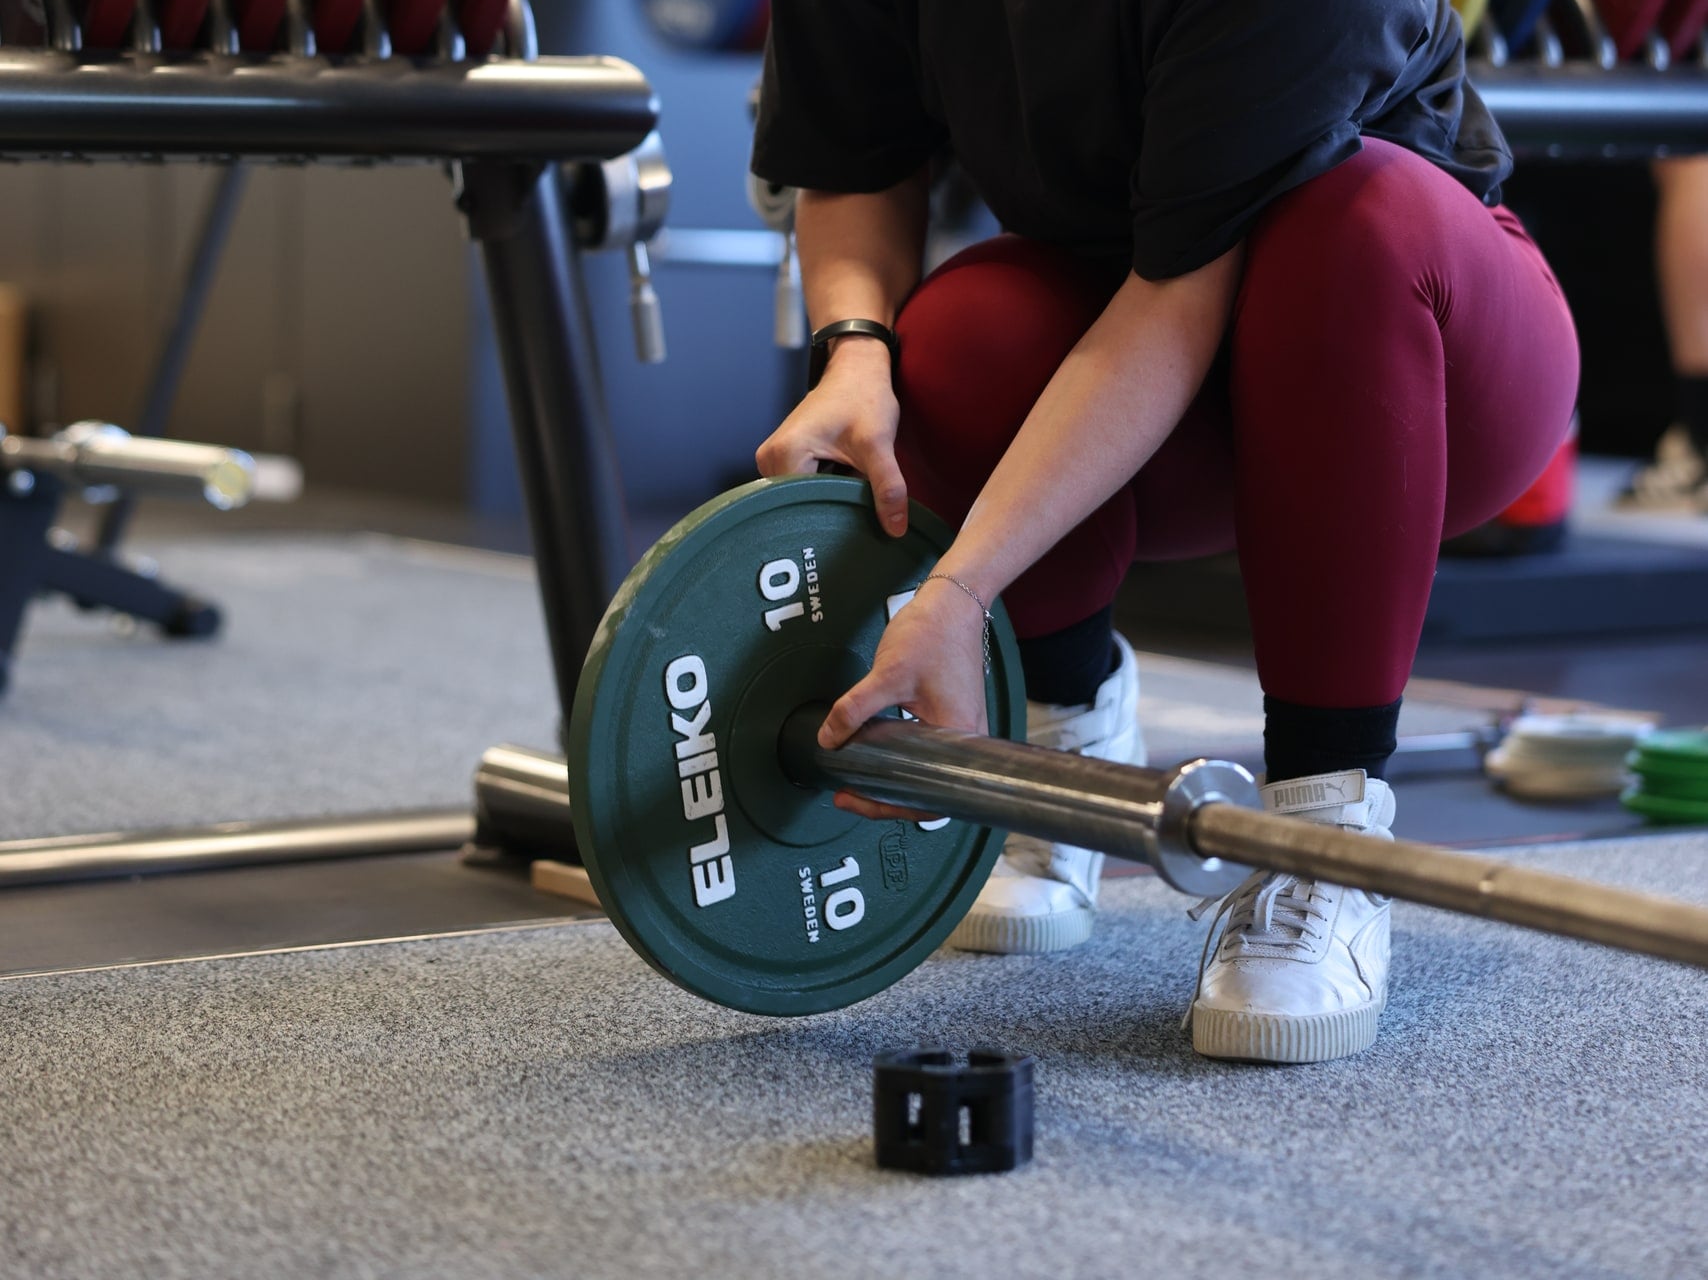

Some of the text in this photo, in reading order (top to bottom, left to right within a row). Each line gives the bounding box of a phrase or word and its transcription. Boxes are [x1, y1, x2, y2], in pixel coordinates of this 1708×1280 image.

[759, 558, 805, 632] 10
[802, 547, 824, 623] SWEDEN
[666, 653, 737, 908] ELEIKO
[1274, 782, 1326, 808] PUMA
[799, 866, 820, 944] SWEDEN
[820, 856, 865, 931] 10
